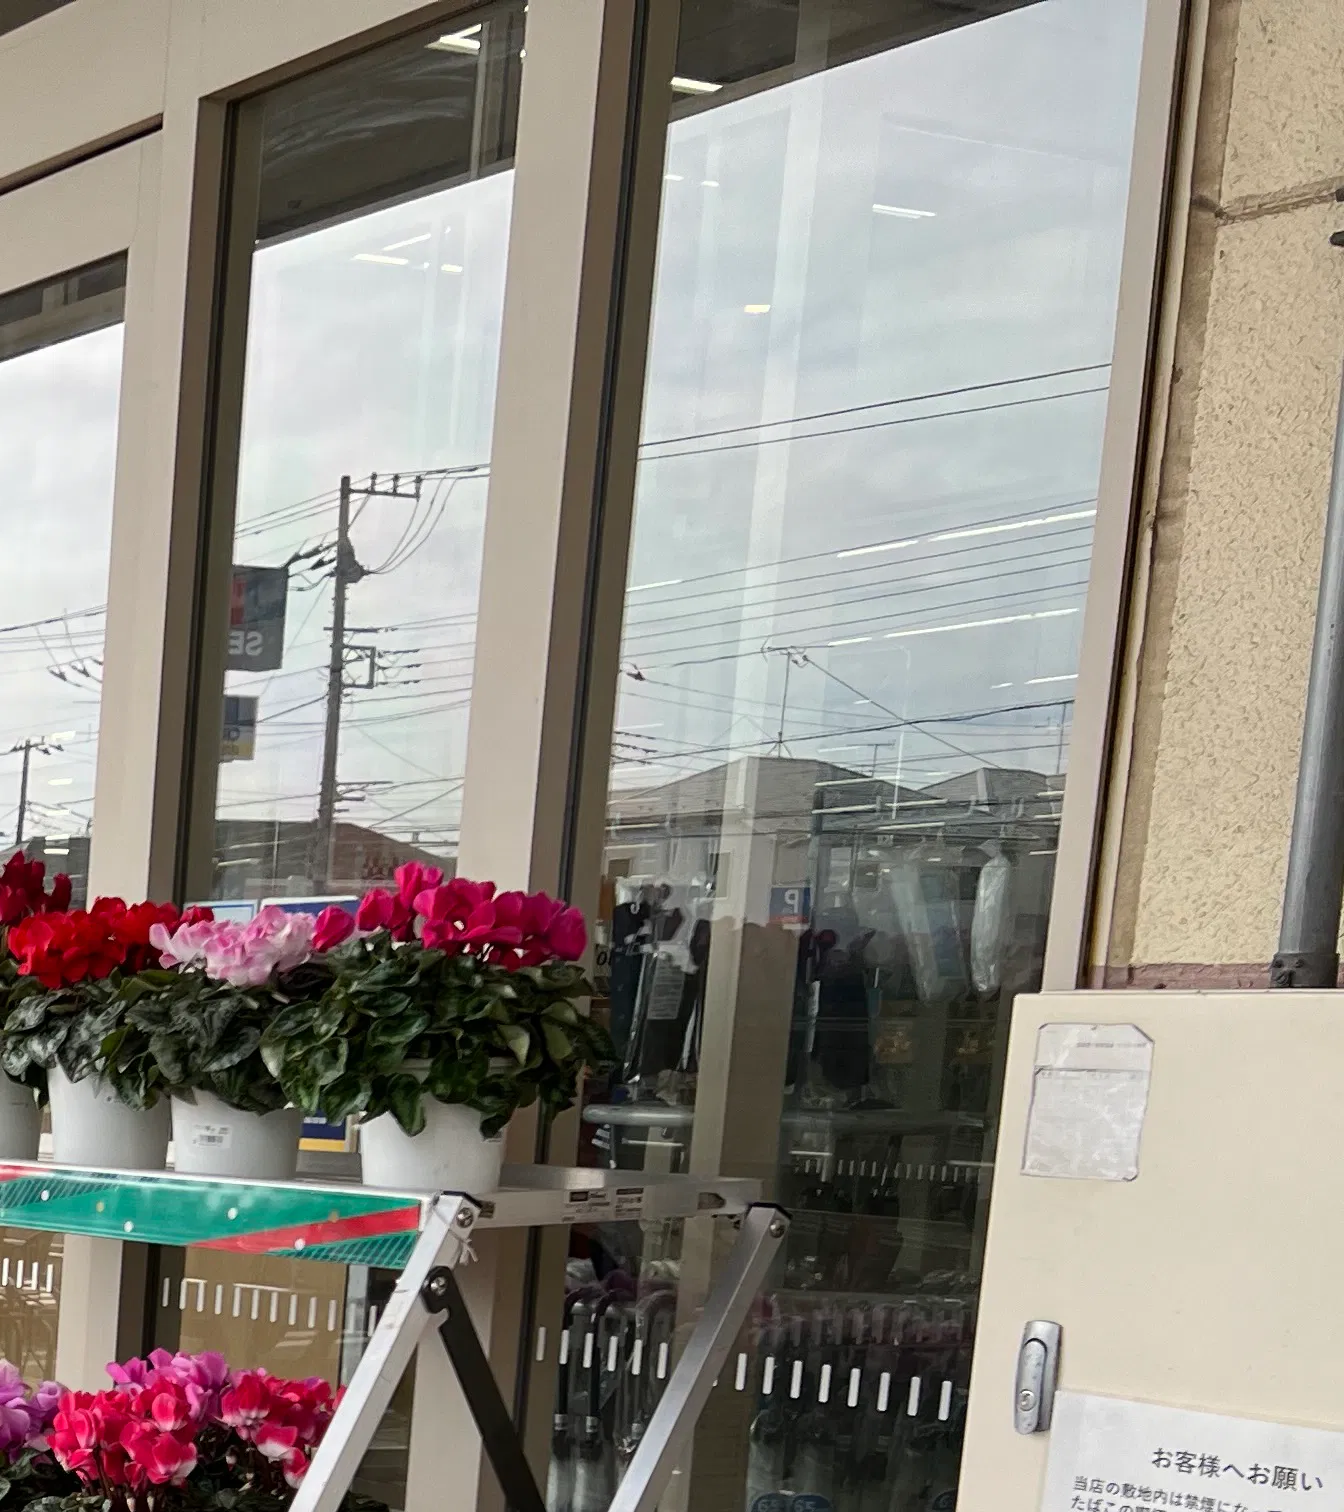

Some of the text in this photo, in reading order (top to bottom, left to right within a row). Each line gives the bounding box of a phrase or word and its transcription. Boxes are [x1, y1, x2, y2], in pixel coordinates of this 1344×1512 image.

[1151, 1447, 1324, 1492] お客様へお願い
